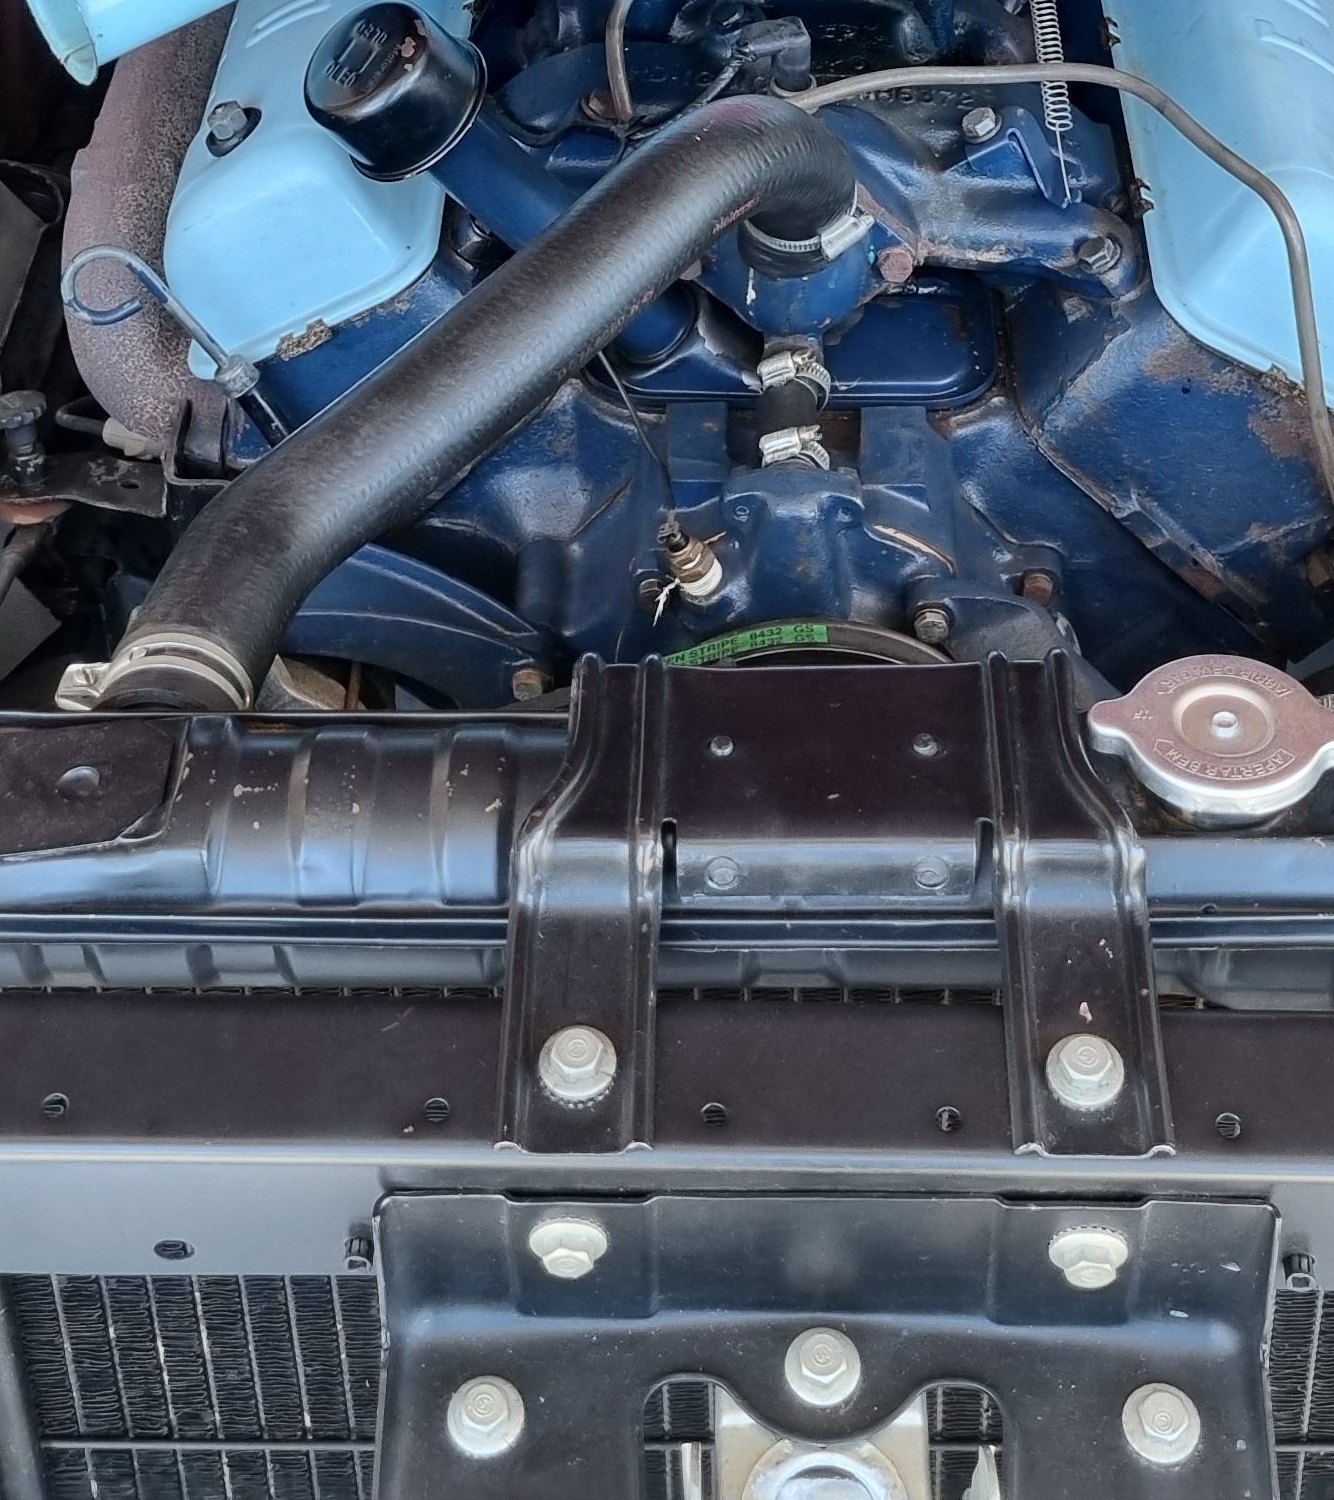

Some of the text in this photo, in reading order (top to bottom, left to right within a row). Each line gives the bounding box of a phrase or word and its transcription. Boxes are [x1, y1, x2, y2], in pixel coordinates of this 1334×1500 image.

[689, 637, 739, 659] STRIPE
[793, 623, 815, 634] GS
[1165, 747, 1285, 780] APERTAR BEM
